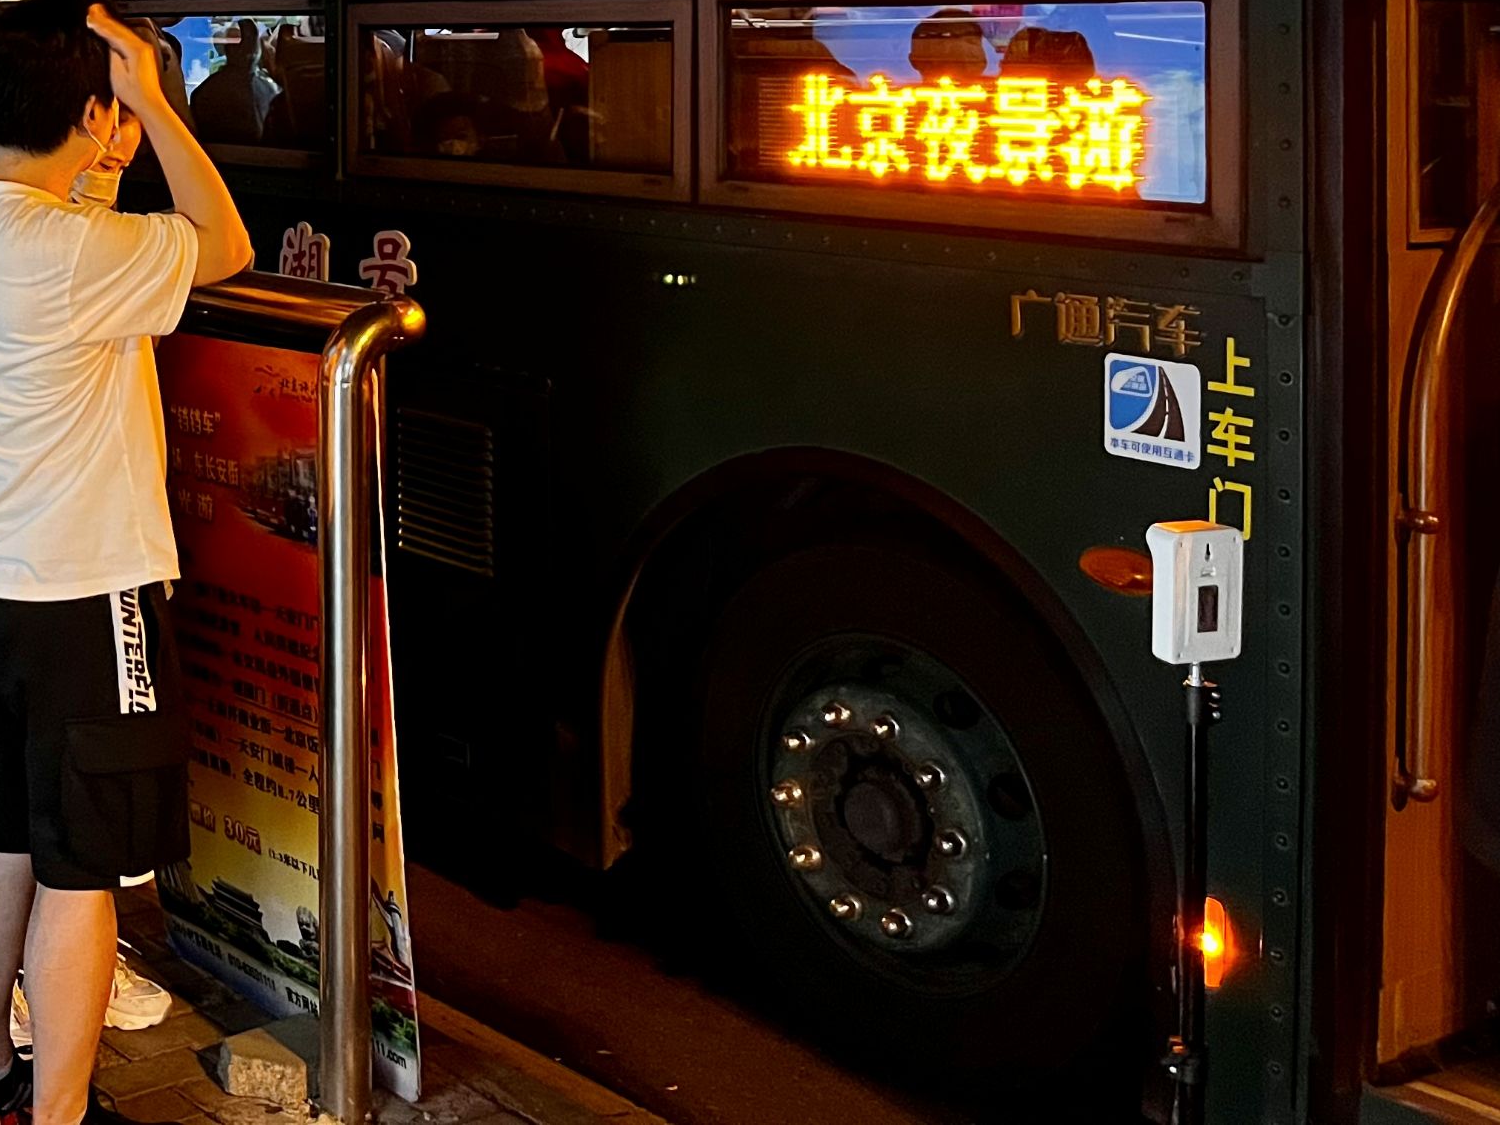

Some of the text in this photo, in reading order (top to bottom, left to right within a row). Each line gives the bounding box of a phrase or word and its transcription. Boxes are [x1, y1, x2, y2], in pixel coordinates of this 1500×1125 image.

[786, 74, 1150, 191] 北京夜景游
[1010, 289, 1203, 357] 广通汽车
[1110, 436, 1196, 464] 本车可使用互通卡
[1207, 335, 1256, 541] 上车门
[223, 815, 262, 856] 30元
